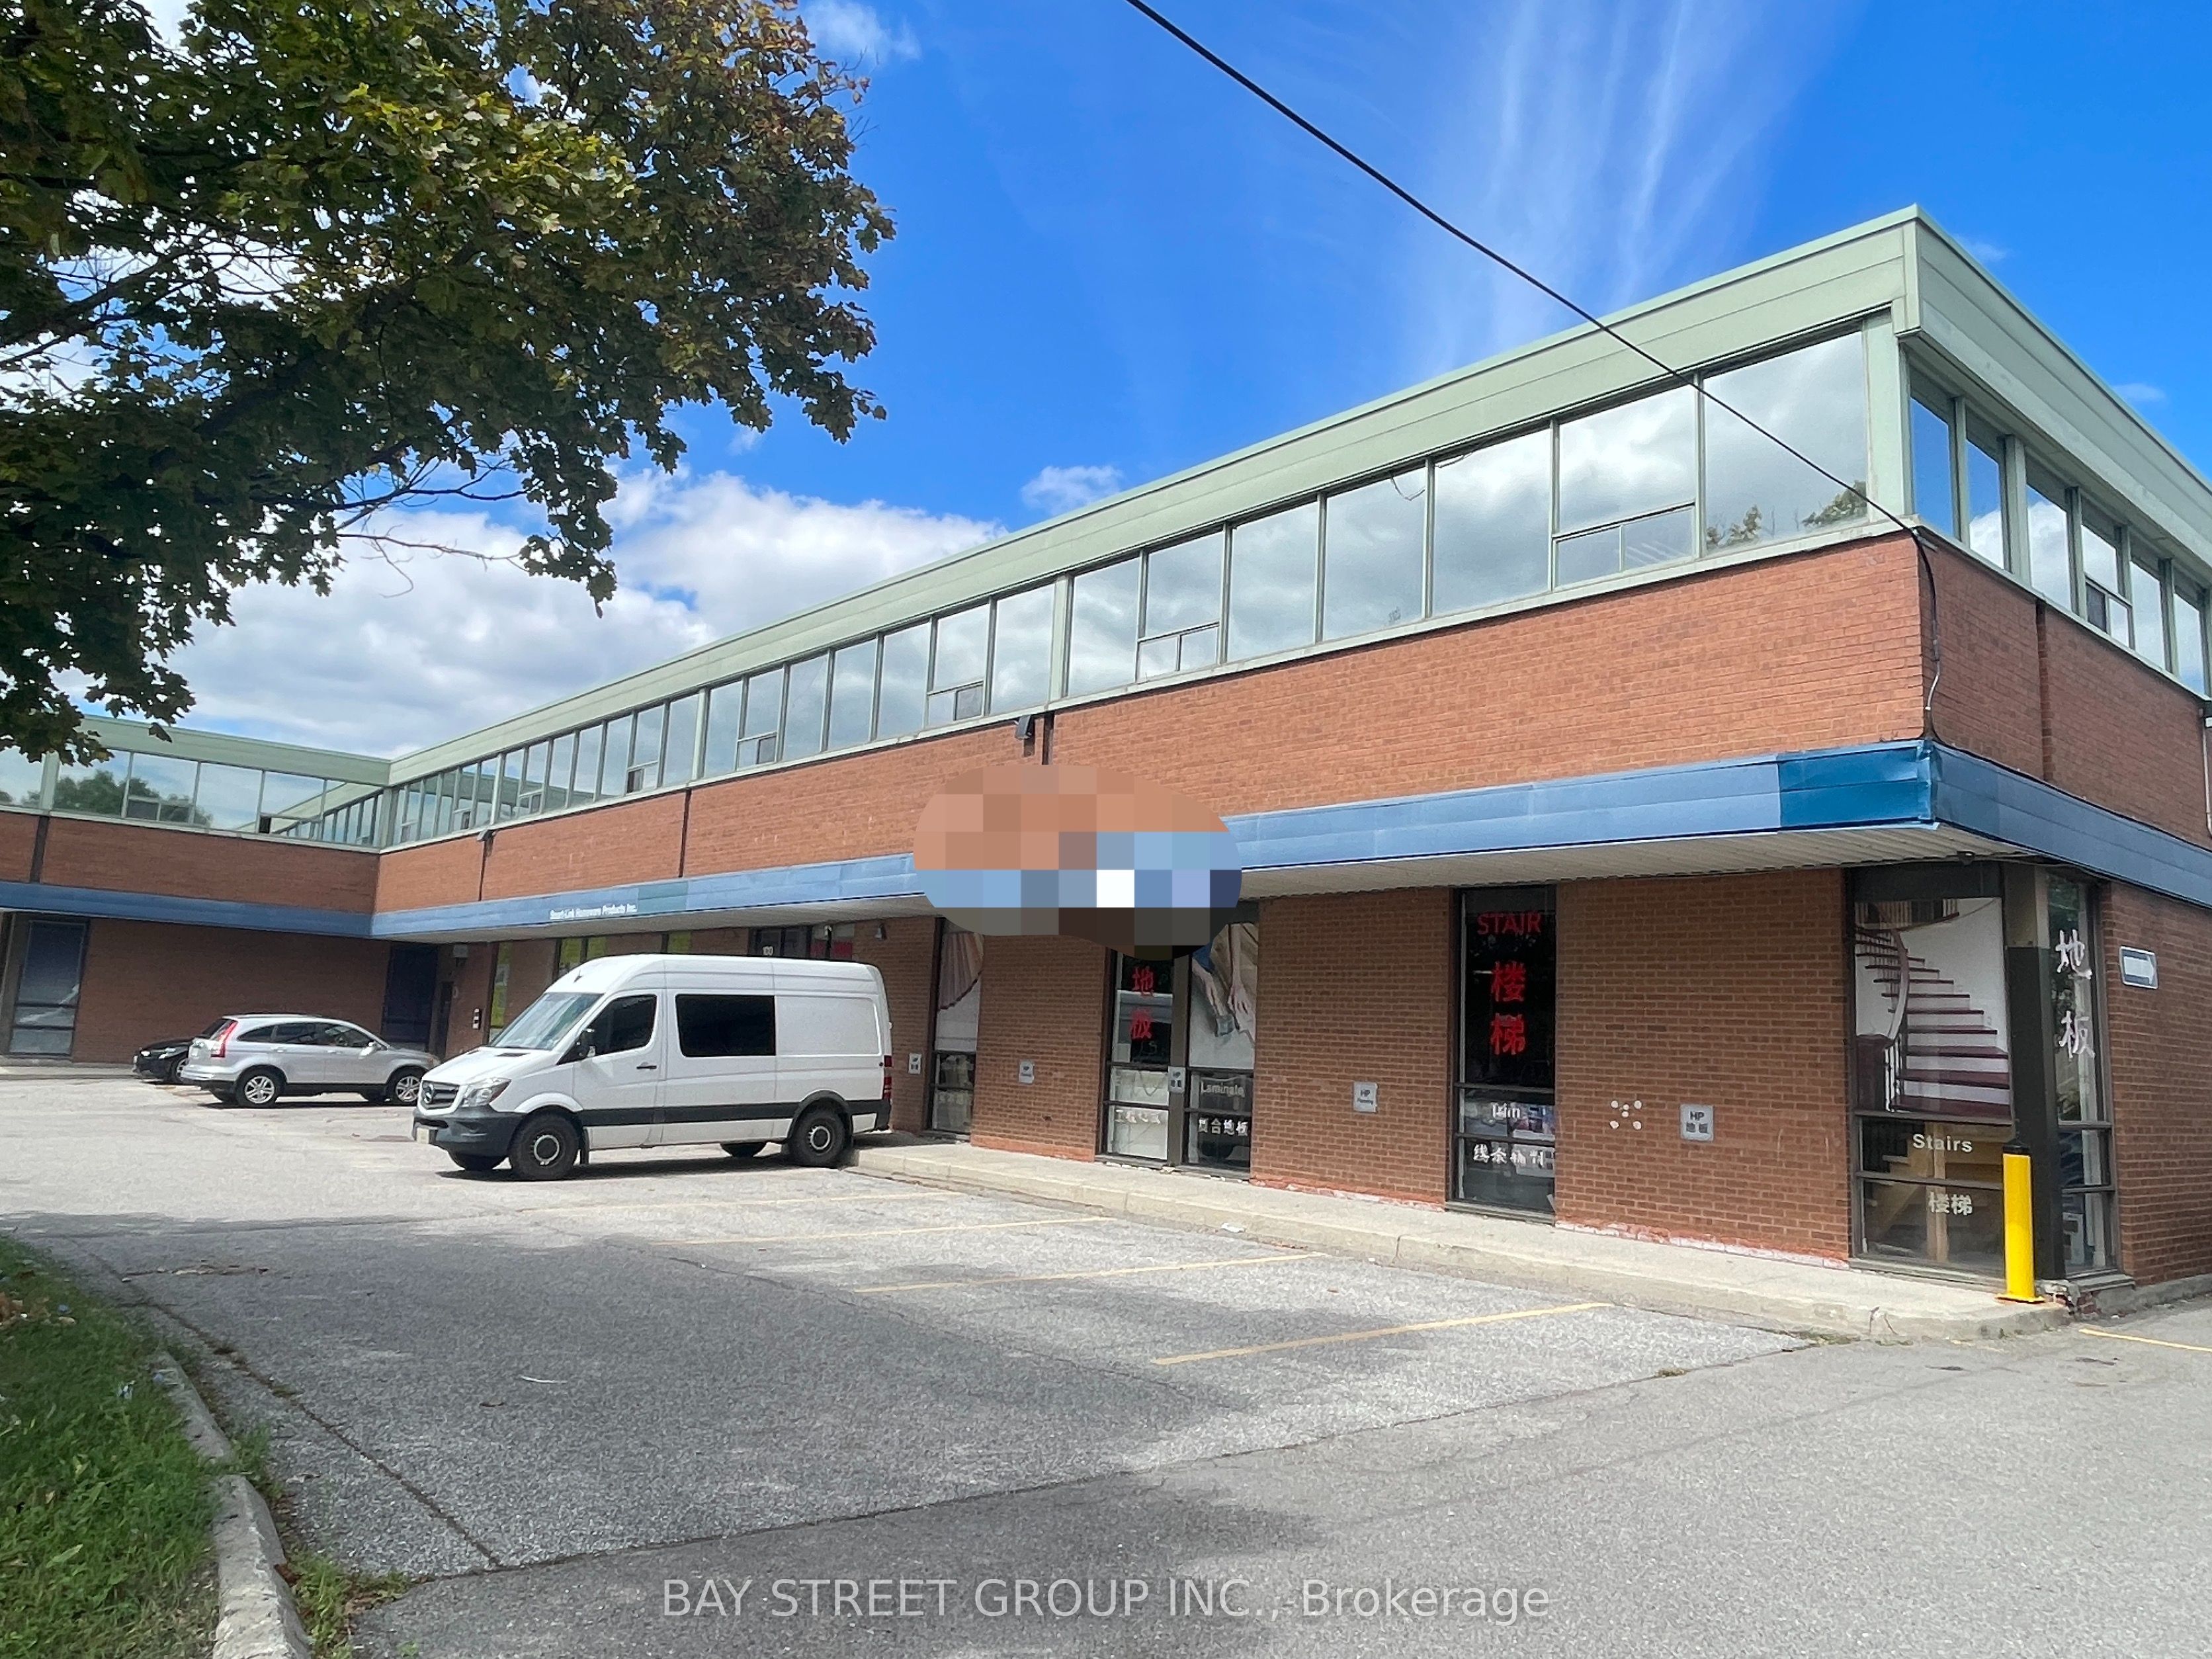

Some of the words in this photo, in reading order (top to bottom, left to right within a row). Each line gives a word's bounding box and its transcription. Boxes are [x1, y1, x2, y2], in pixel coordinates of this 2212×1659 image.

[1477, 912, 1541, 936] STAIR
[2055, 929, 2096, 1062] 地板
[1490, 961, 1526, 1056] 楼梯
[1912, 1133, 1973, 1152] Stairs
[1928, 1192, 1973, 1216] 楼梯
